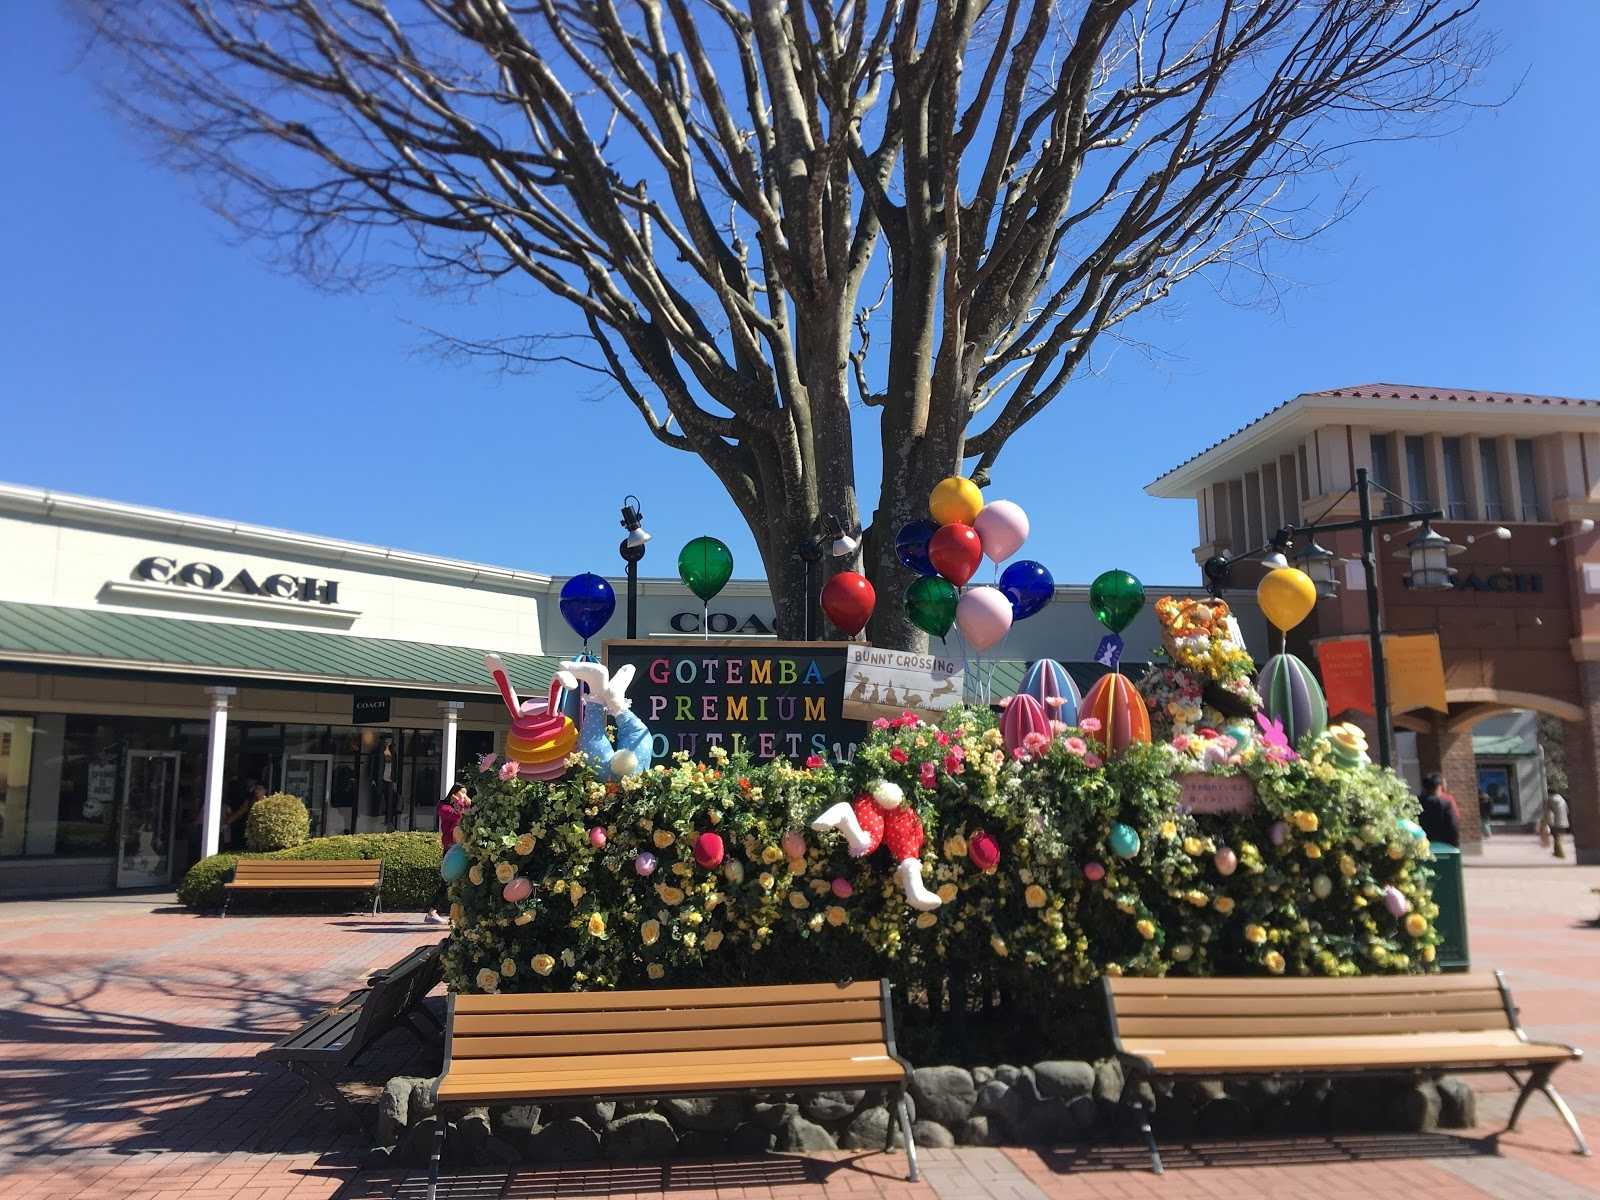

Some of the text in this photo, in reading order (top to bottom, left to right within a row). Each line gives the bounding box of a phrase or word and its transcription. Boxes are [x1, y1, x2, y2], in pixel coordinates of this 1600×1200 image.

[136, 556, 339, 604] COACH
[1402, 573, 1544, 593] ACH
[670, 612, 778, 633] COA
[650, 659, 825, 685] GOTEMBA
[855, 650, 954, 674] BUNNY CROSSING
[649, 695, 827, 721] PREMIUM
